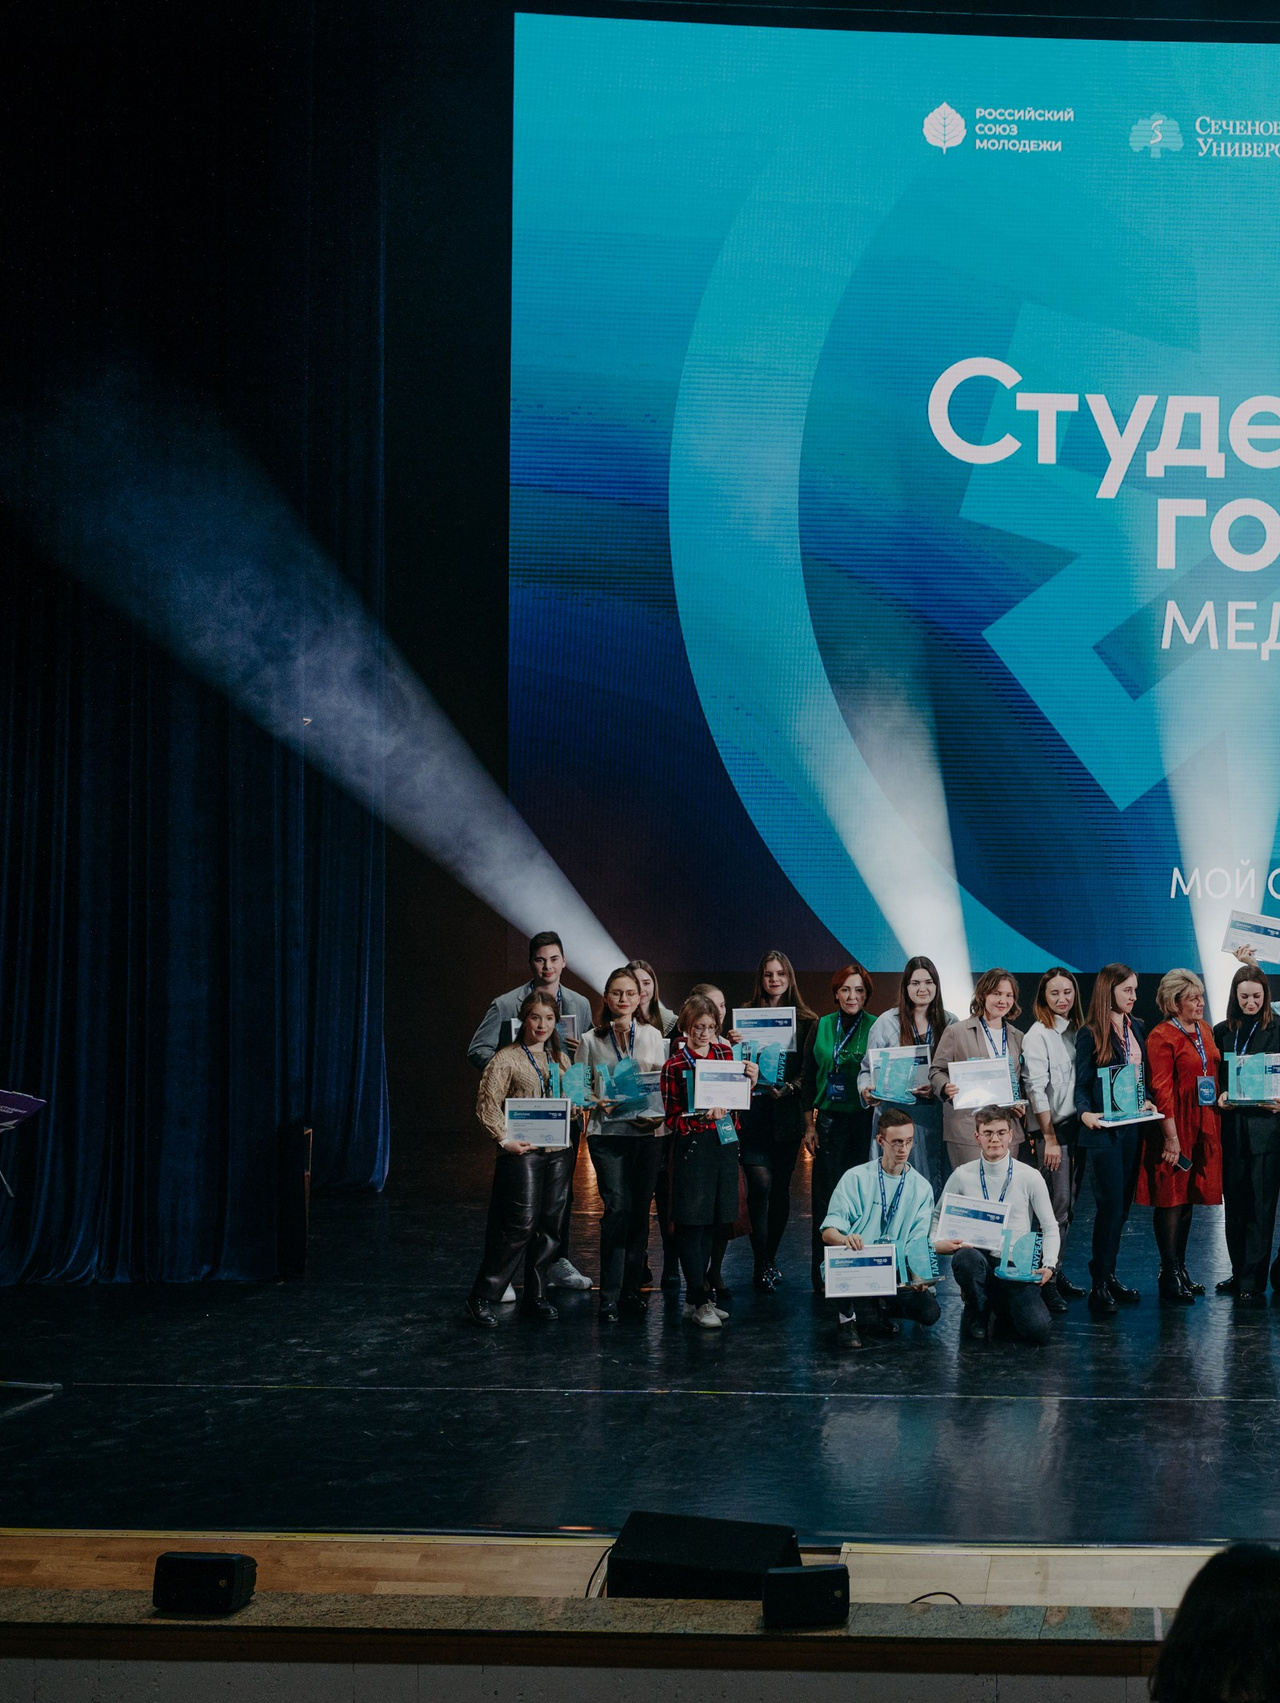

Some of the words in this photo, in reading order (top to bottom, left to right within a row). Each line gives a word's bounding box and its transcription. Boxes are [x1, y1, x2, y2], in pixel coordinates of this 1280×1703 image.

[975, 107, 1074, 122] РОССИЙСКИЙ
[975, 123, 1018, 136] СОЮЗ
[975, 138, 1062, 152] МОЛОДЕЖИ
[1170, 859, 1256, 899] МОЙ
[777, 1049, 787, 1082] ЛАУРЕА
